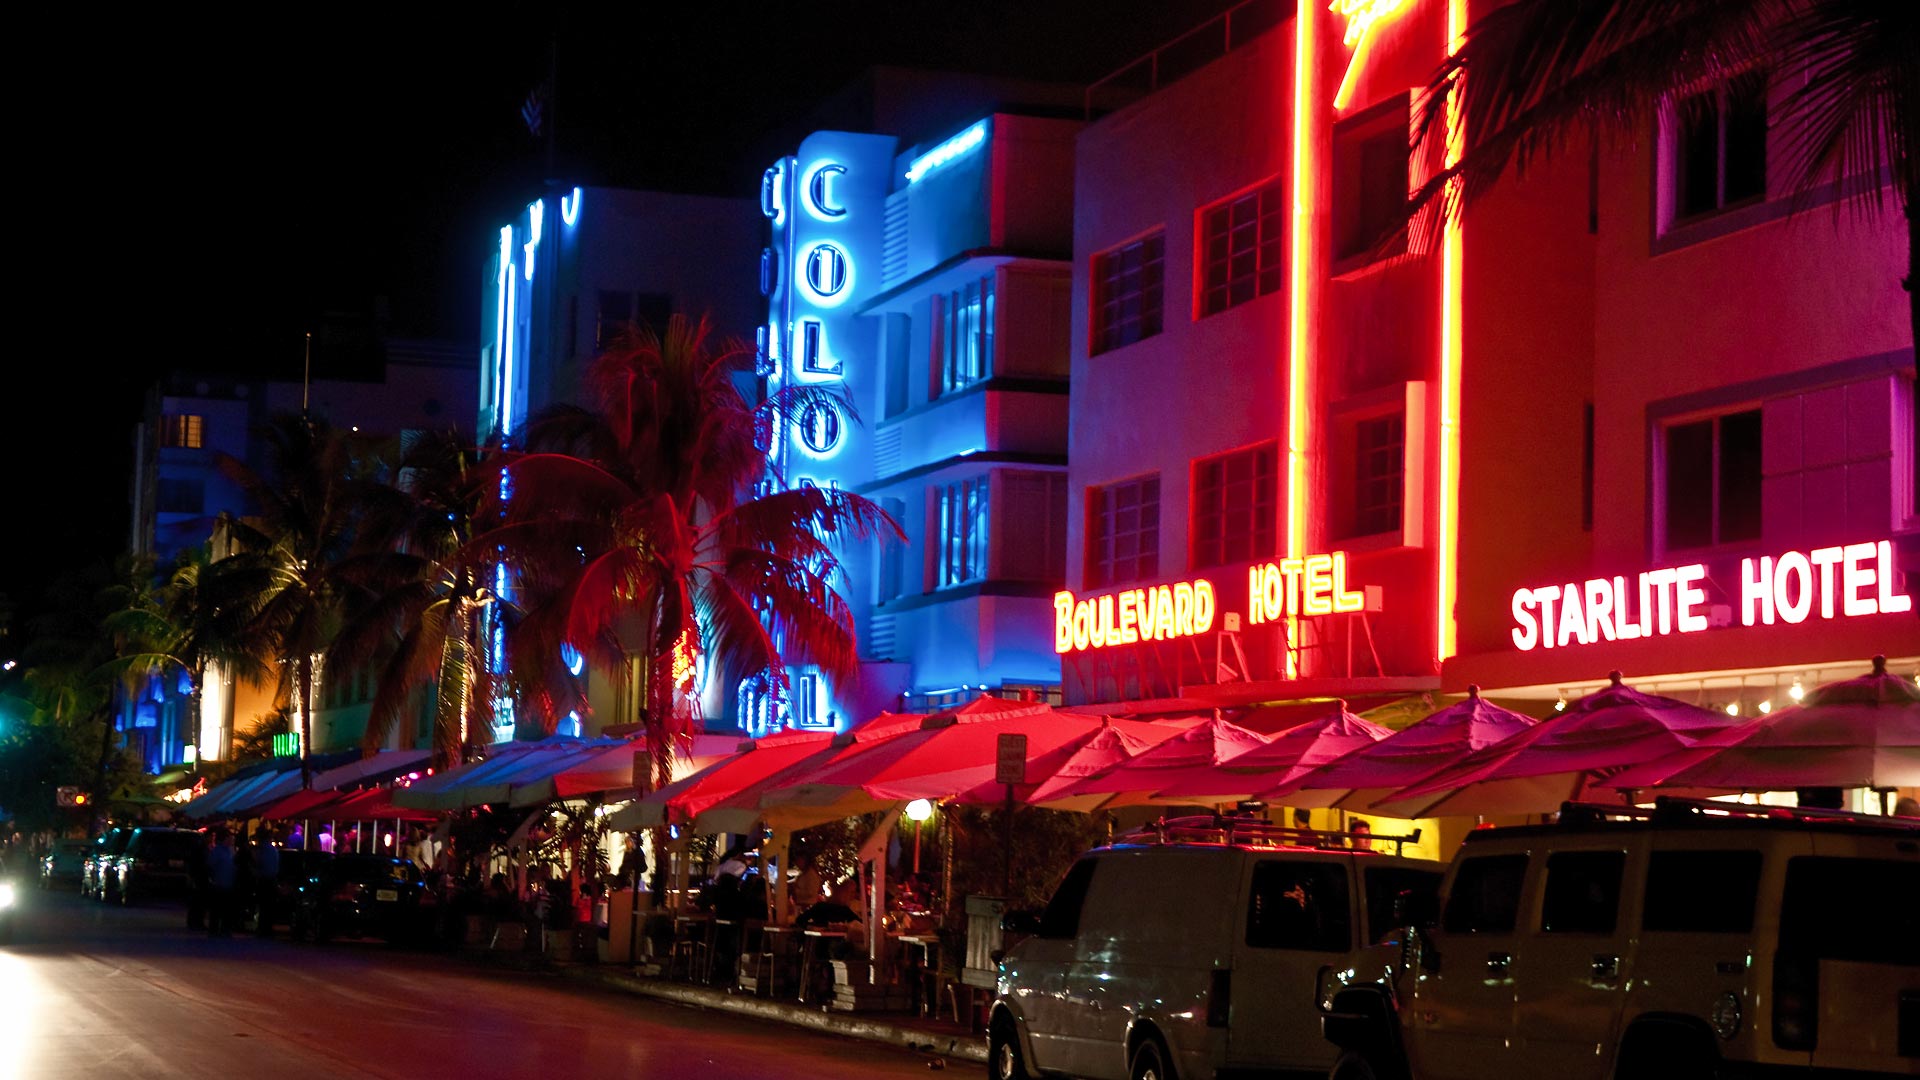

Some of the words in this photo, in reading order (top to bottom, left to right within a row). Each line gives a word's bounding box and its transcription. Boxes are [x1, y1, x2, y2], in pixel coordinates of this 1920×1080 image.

[1054, 578, 1216, 653] BOULEVARD
[1248, 551, 1365, 625] HOTEL
[1511, 563, 1708, 651] STARLITE
[1741, 540, 1912, 627] HOTEL
